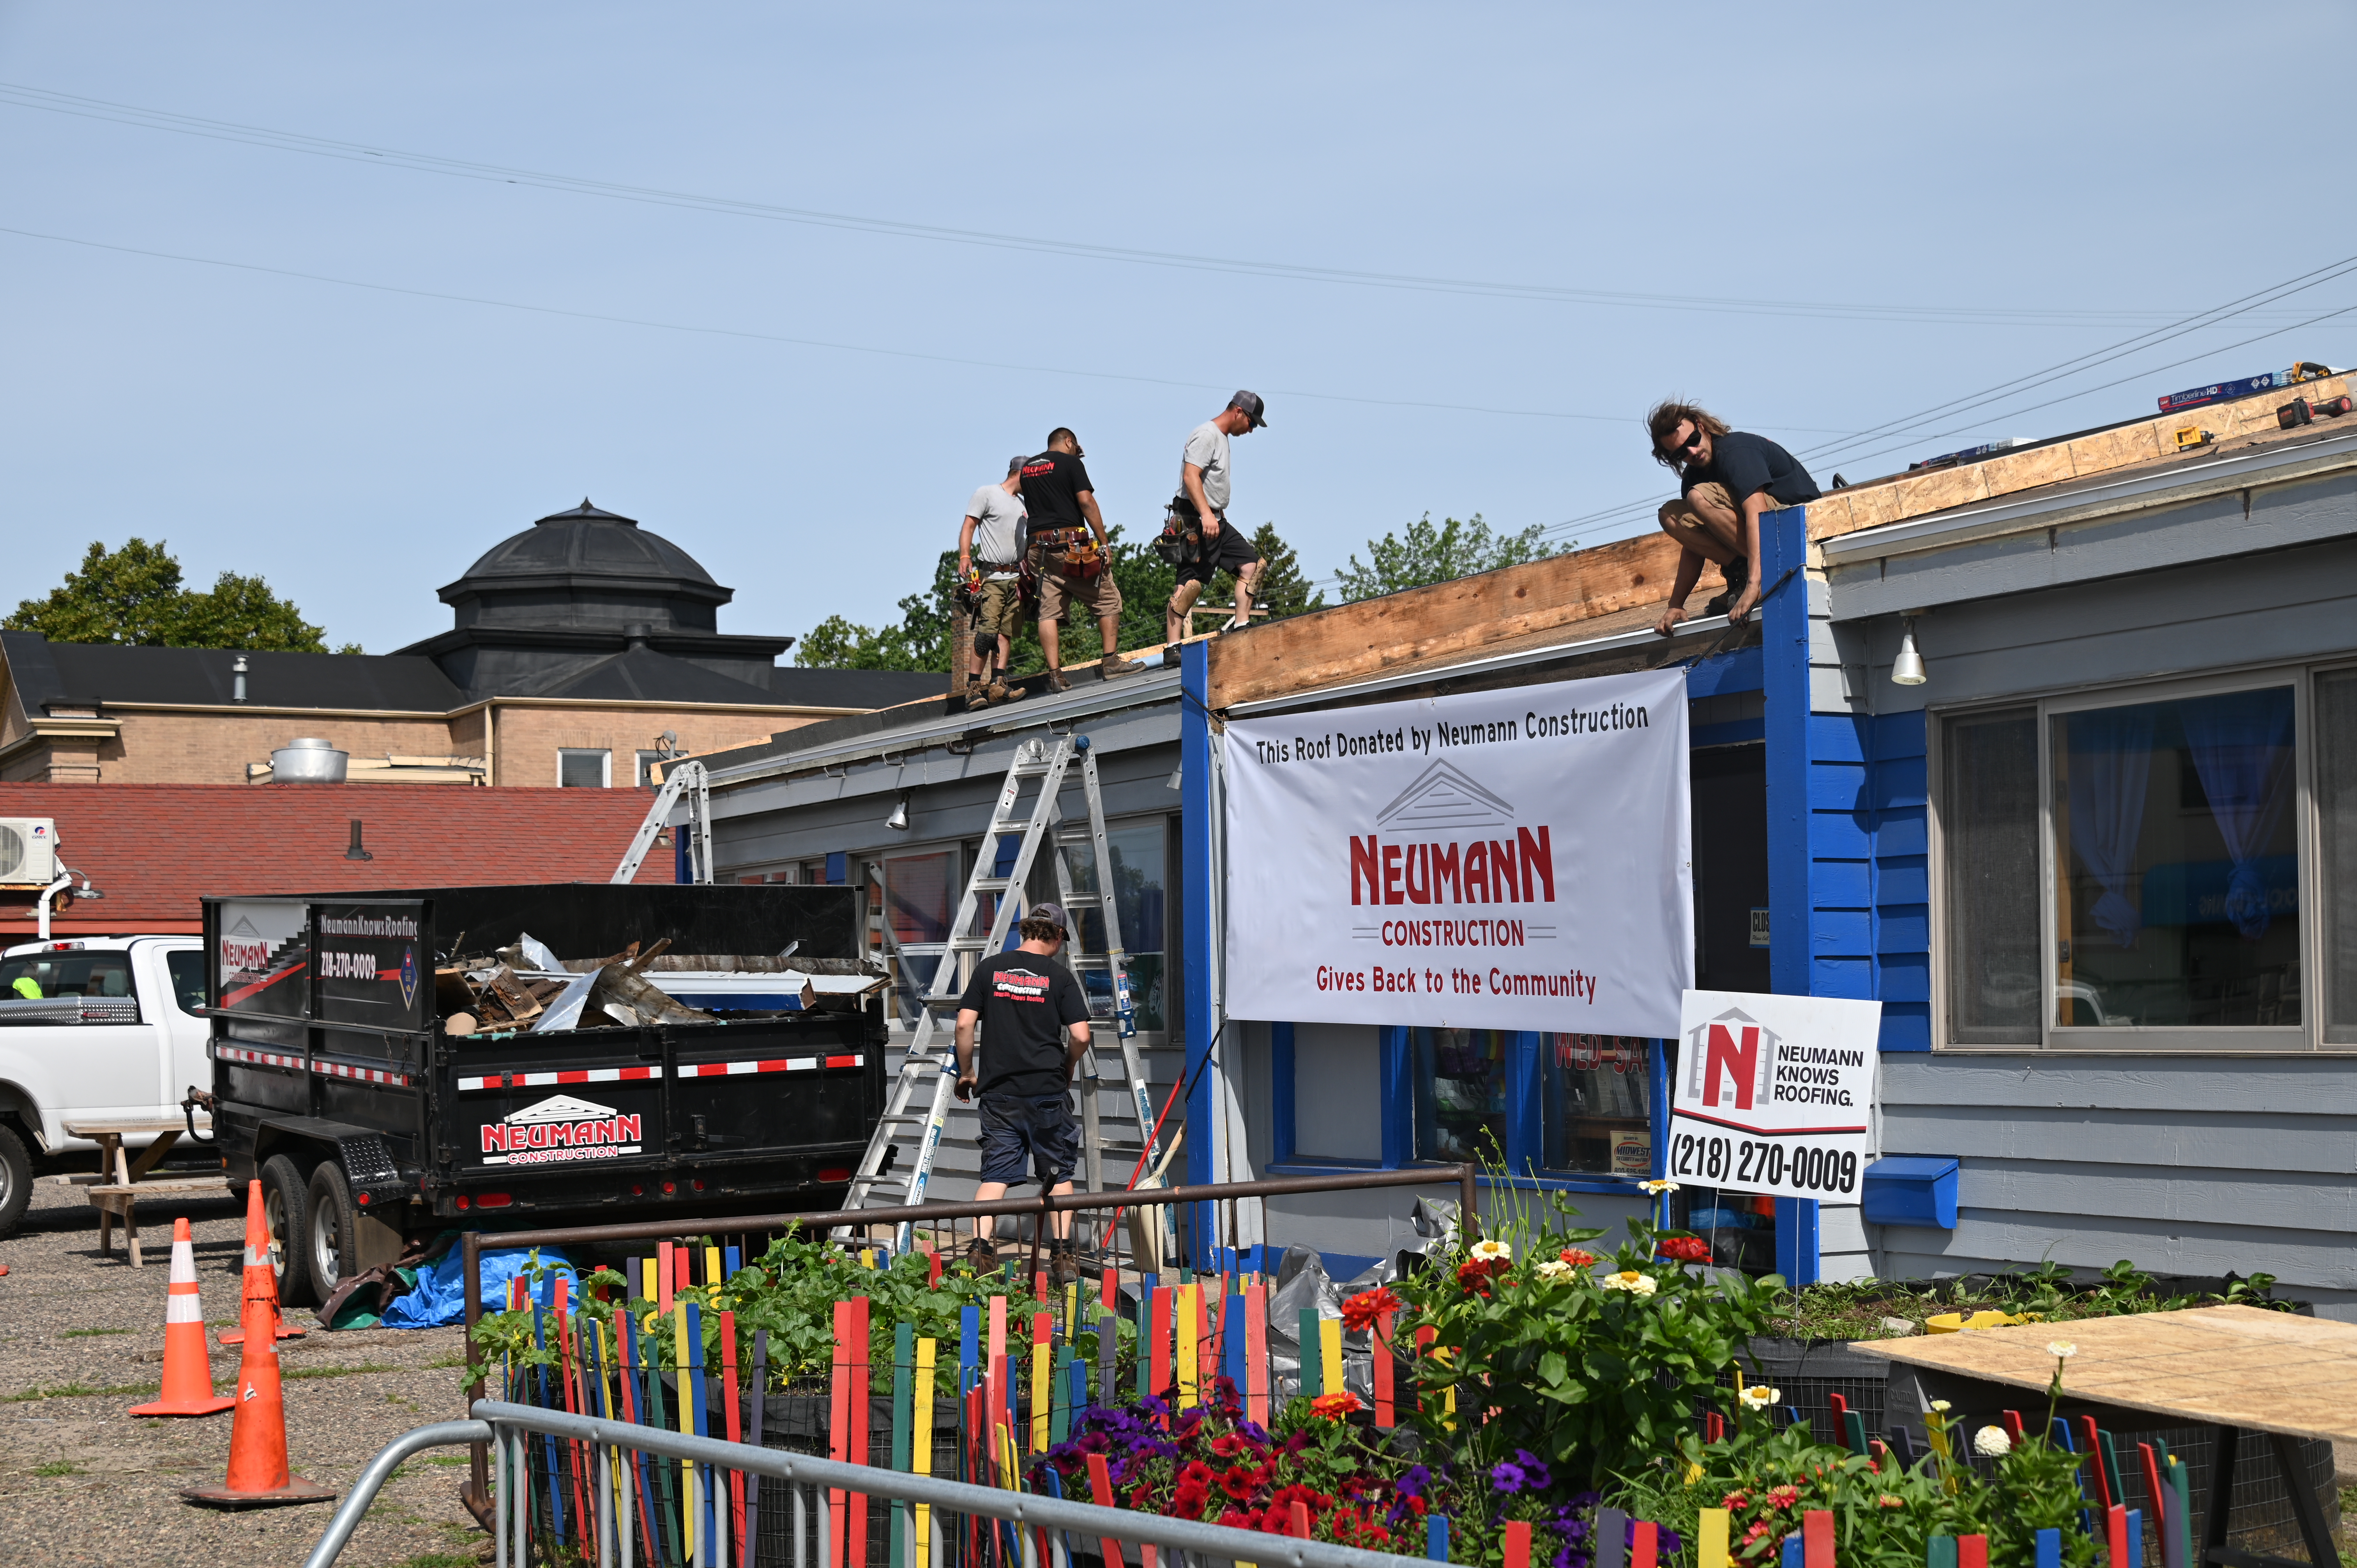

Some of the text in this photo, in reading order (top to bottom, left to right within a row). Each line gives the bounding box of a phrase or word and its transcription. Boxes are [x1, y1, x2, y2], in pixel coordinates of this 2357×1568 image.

[2171, 390, 2206, 402] Timberline
[2206, 385, 2222, 395] HDZ
[1256, 703, 1648, 765] This Roof Donated by Neumann Construction
[1349, 825, 1555, 906] NEUMANN
[1382, 919, 1524, 946] CONSTRUCTION
[223, 939, 268, 969] NEUMANN
[321, 952, 376, 980] 218-270-0009
[229, 972, 261, 984] CONSTRUCTION
[994, 971, 1050, 988] NEUMANN
[1316, 965, 1596, 1005] Gives Back to the Community
[1553, 1032, 1602, 1070] WED
[1778, 1045, 1863, 1067] NEUMANN
[1776, 1065, 1839, 1086] KNOWS
[1774, 1084, 1853, 1107] ROOFING.
[481, 1114, 641, 1152] NEUMANN
[508, 1145, 618, 1165] CONSTRUCTION
[1616, 1146, 1651, 1157] MIDWEST
[1671, 1133, 1857, 1194] (218) 270-0009
